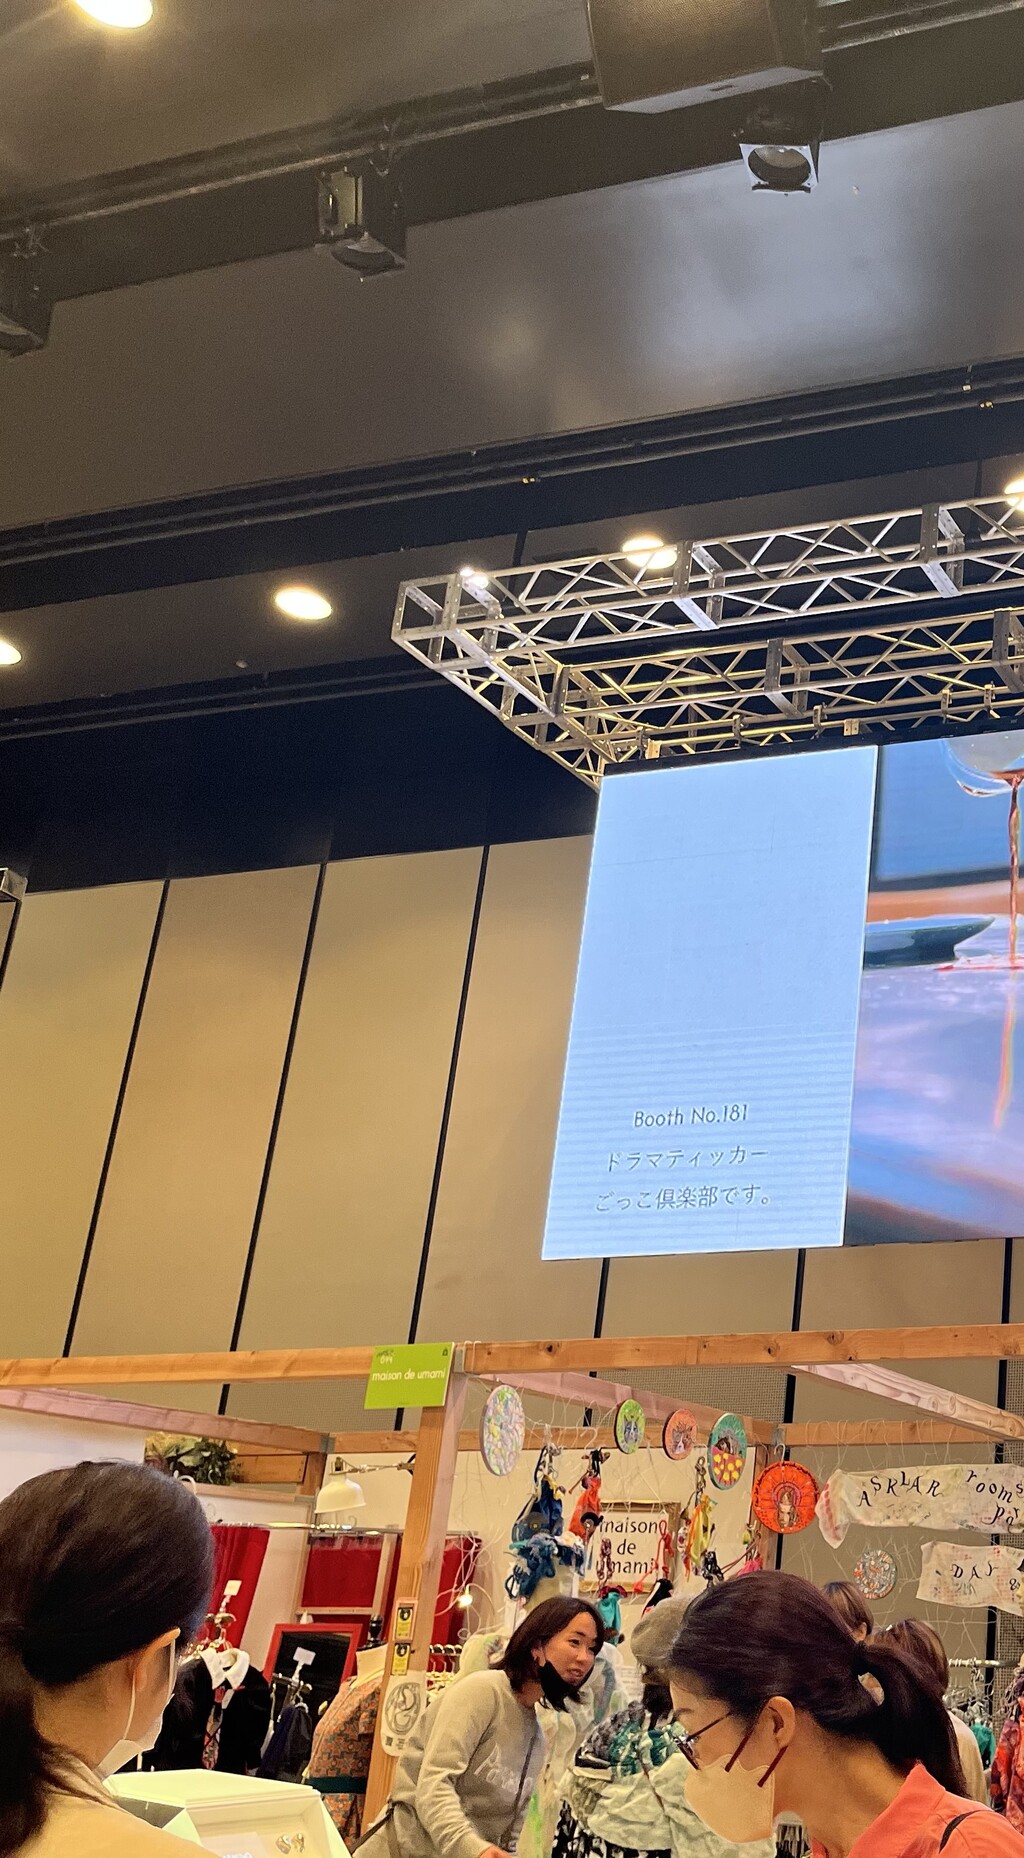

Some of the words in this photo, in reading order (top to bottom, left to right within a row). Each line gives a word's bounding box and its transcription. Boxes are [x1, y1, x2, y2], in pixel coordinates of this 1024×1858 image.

[633, 1107, 684, 1128] Booth
[691, 1104, 748, 1124] No.181
[607, 1145, 769, 1172] ドラマティッカー
[372, 1370, 402, 1380] maison
[404, 1368, 415, 1380] de
[417, 1368, 446, 1379] umami
[857, 1470, 944, 1507] ASKLAR
[600, 1517, 657, 1533] maison
[617, 1538, 636, 1555] de
